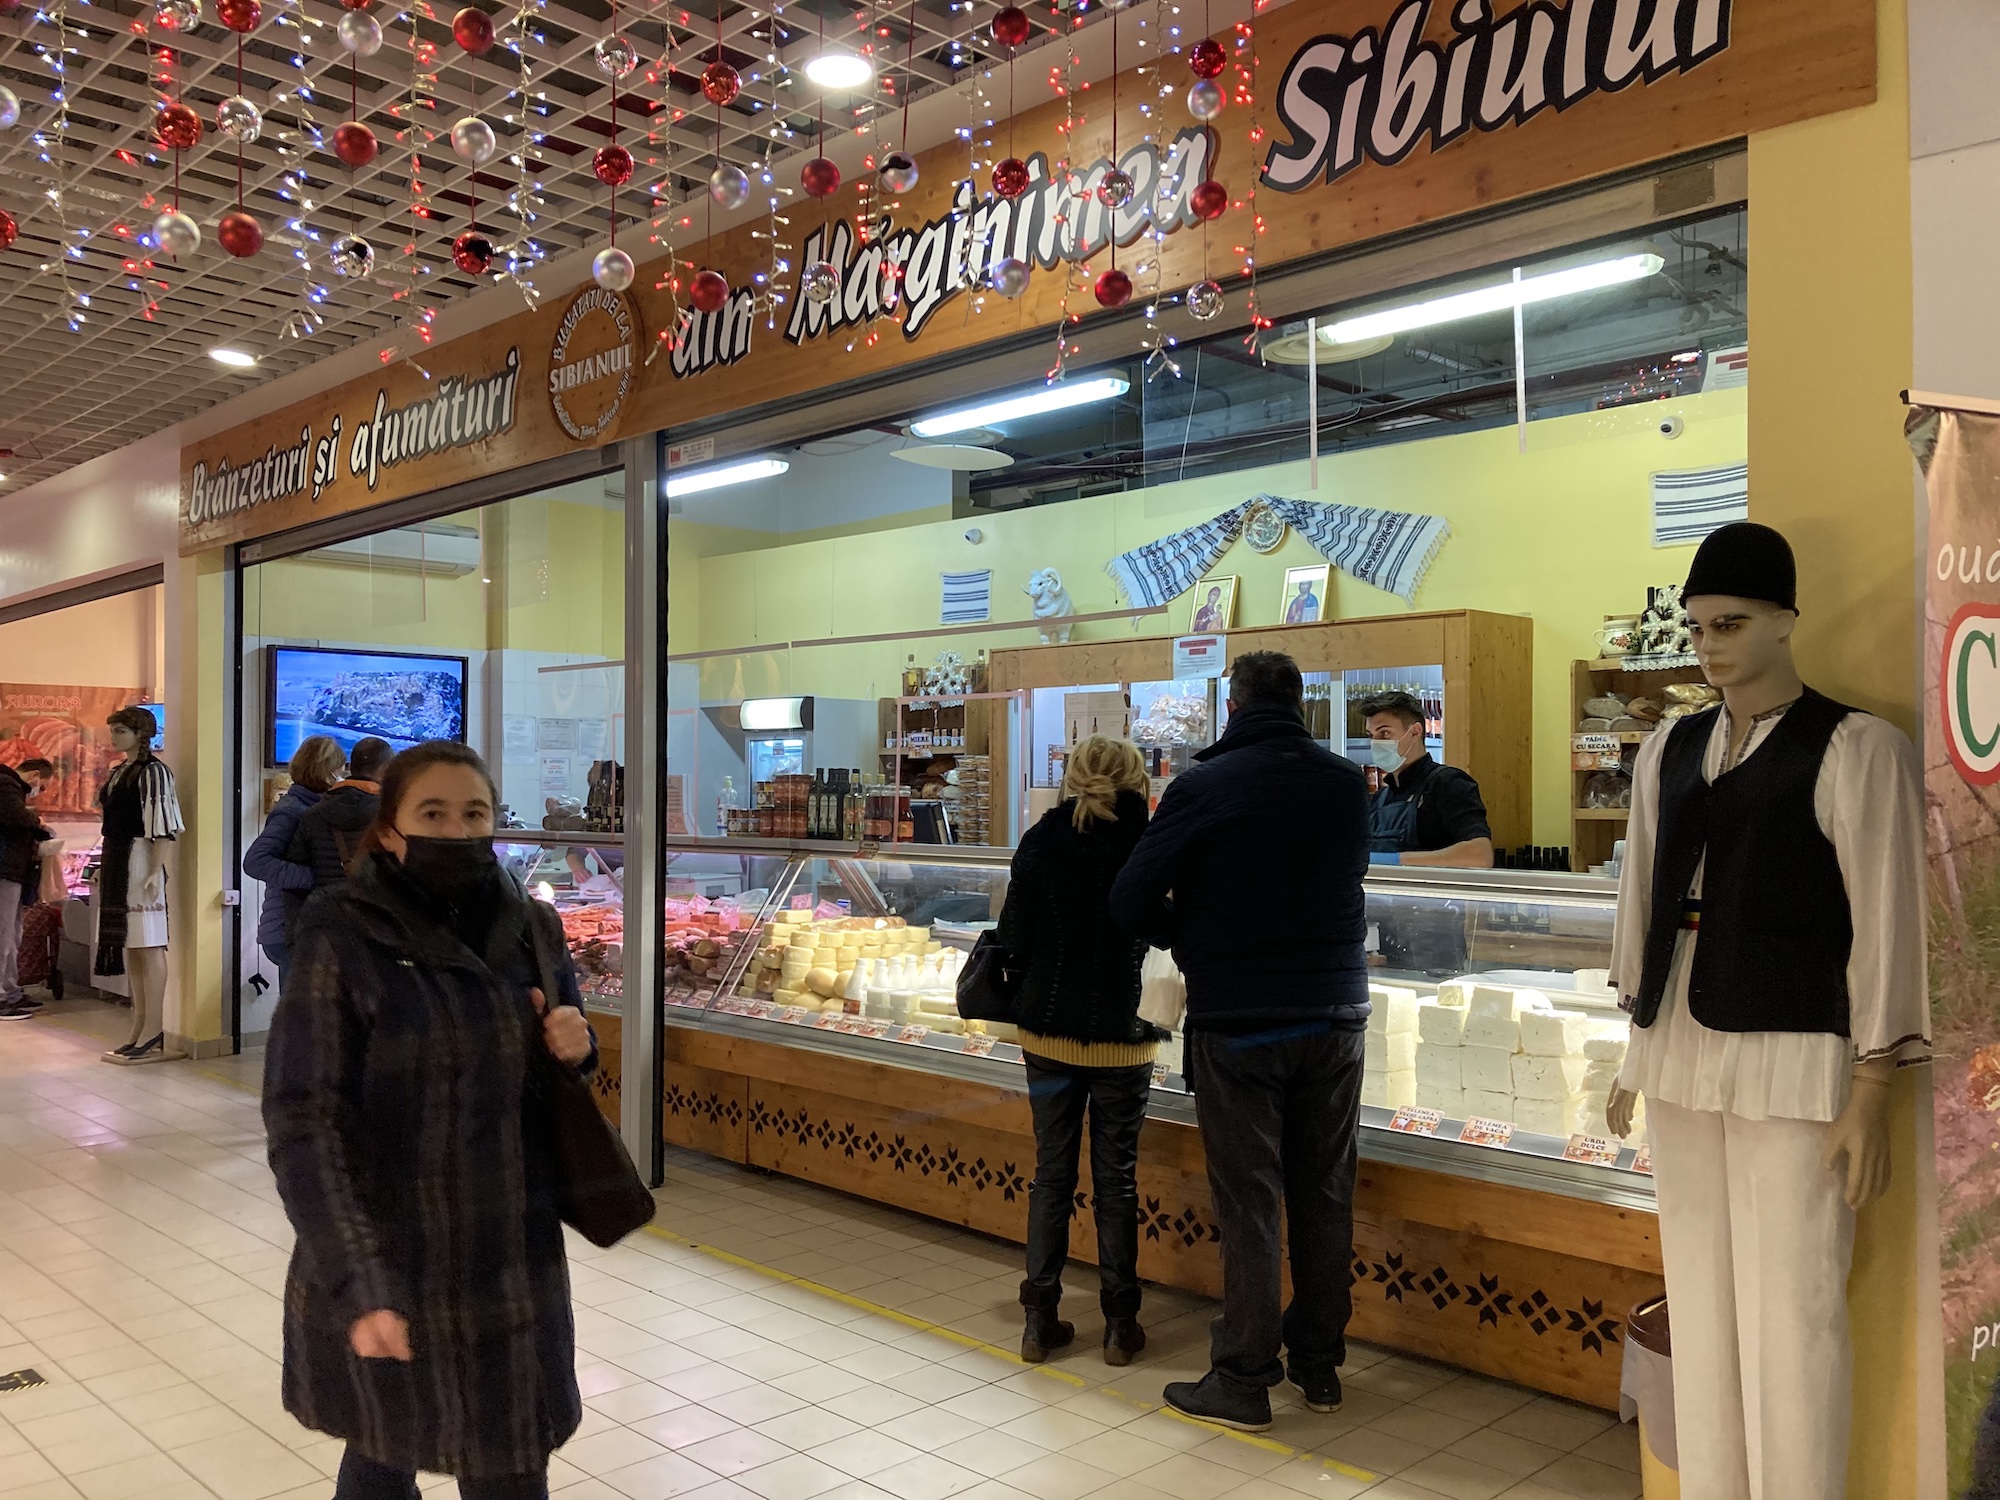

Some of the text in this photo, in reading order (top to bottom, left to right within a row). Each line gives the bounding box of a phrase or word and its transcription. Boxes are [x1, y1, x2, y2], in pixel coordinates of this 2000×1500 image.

[601, 290, 621, 318] DE
[615, 311, 631, 341] LA
[549, 342, 633, 394] SIBIANUL
[188, 345, 520, 526] Brânzeturi și afumături
[4, 693, 82, 711] AURORA
[910, 734, 930, 743] MIERE
[1406, 1107, 1435, 1117] TELEMEA
[1418, 1113, 1438, 1122] CAPRA
[1475, 1120, 1508, 1130] TELEMEA
[1584, 1137, 1606, 1145] URDA
[1580, 1142, 1606, 1151] DULCE
